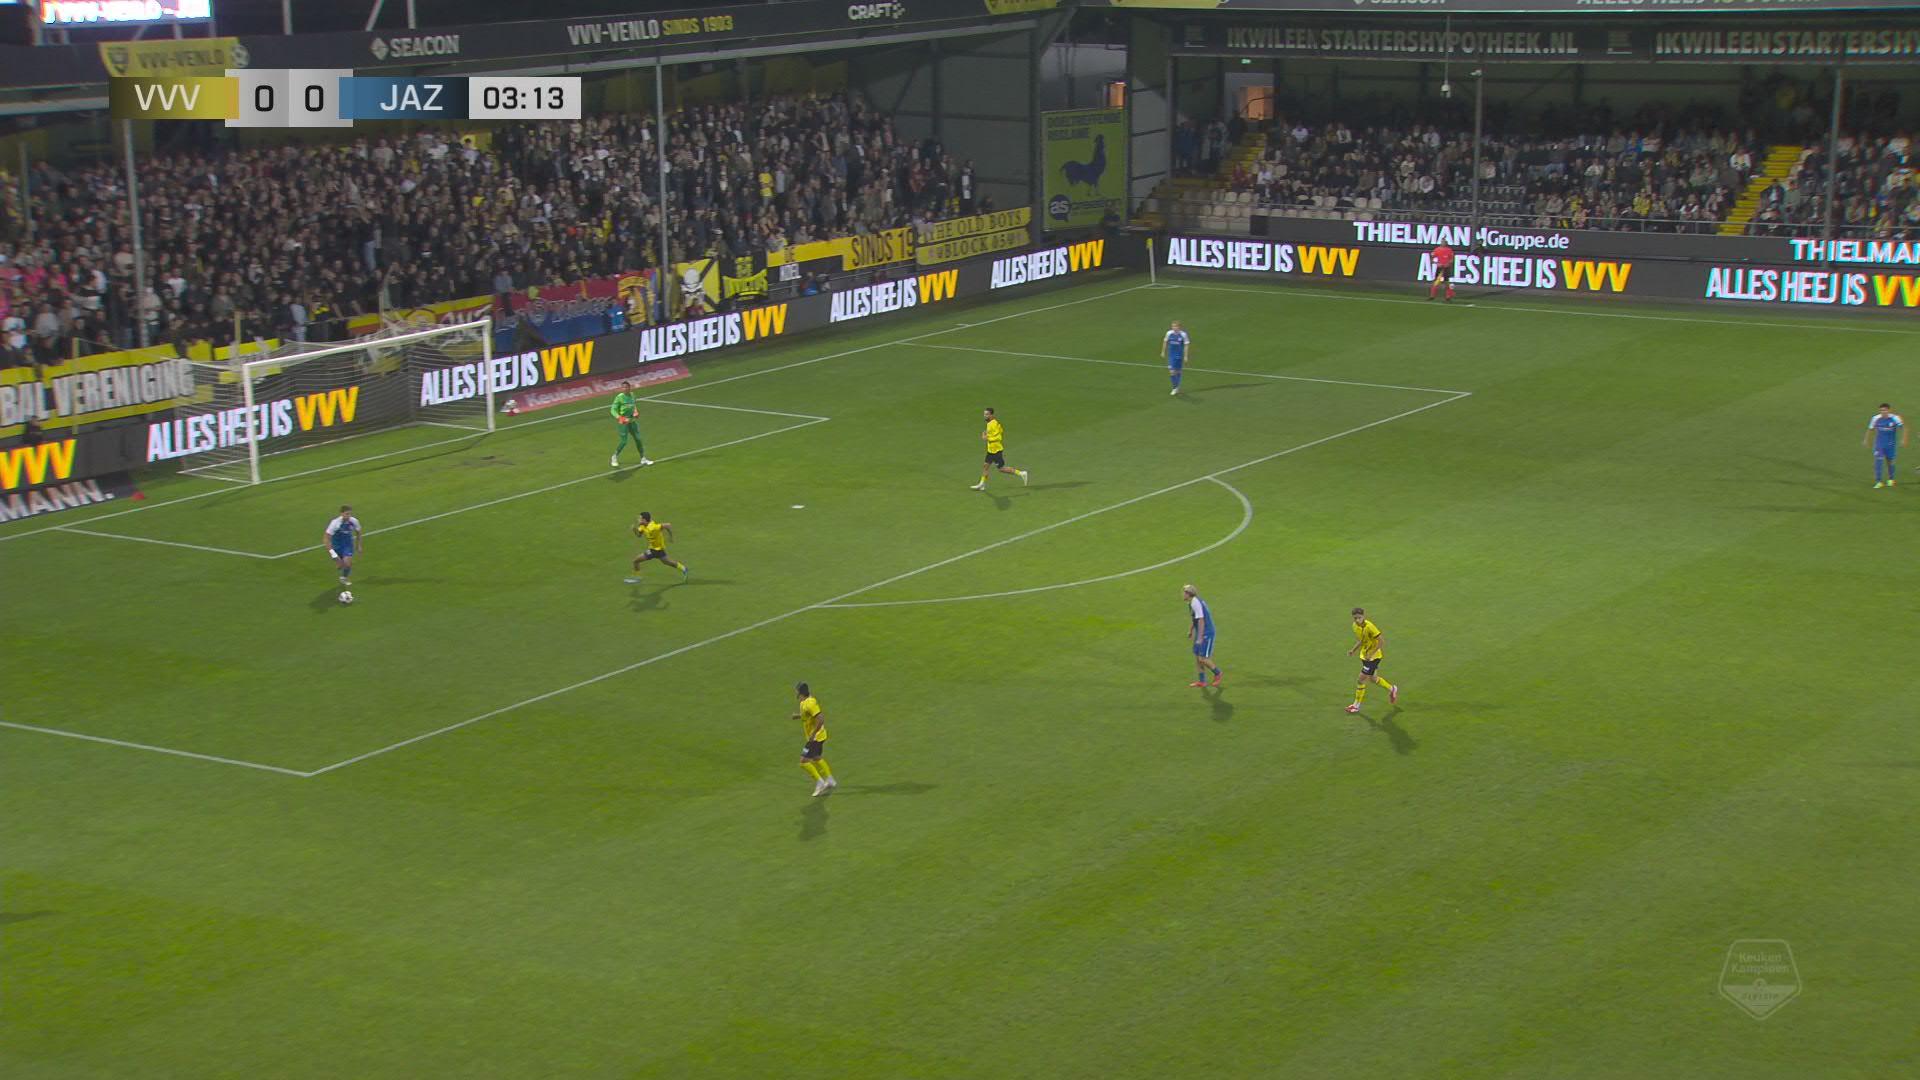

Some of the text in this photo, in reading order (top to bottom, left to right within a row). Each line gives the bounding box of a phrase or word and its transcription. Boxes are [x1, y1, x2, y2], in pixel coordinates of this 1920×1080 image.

[567, 15, 734, 46] VVV-VENLO SINDS 1903
[848, 2, 893, 20] CRAFT
[389, 35, 460, 58] SEACON
[957, 217, 984, 236] OLD
[851, 231, 894, 267] SINDS
[990, 239, 1105, 289] ALLES HEEJ IS VVV
[1167, 237, 1361, 276] ALLES HEEJ IS VVV
[1483, 256, 1533, 287] HEEJ
[1535, 258, 1557, 289] IS
[1561, 260, 1633, 292] VVV
[1705, 267, 1778, 301] ALLES
[1780, 270, 1839, 304] HEEJ
[1841, 273, 1867, 305] IS
[829, 269, 959, 323] ALLES HEEJ IS VVV
[638, 303, 788, 363] ALLES HEEJ IS VVV
[53, 358, 195, 417] VERENIGING
[420, 363, 476, 407] ALLES
[520, 351, 539, 387] IS
[539, 340, 595, 382] VVV
[525, 385, 593, 406] Keuken
[593, 367, 679, 393] Kampioen
[146, 413, 217, 463] ALLES
[271, 399, 293, 438] IS
[294, 386, 360, 431] VVV
